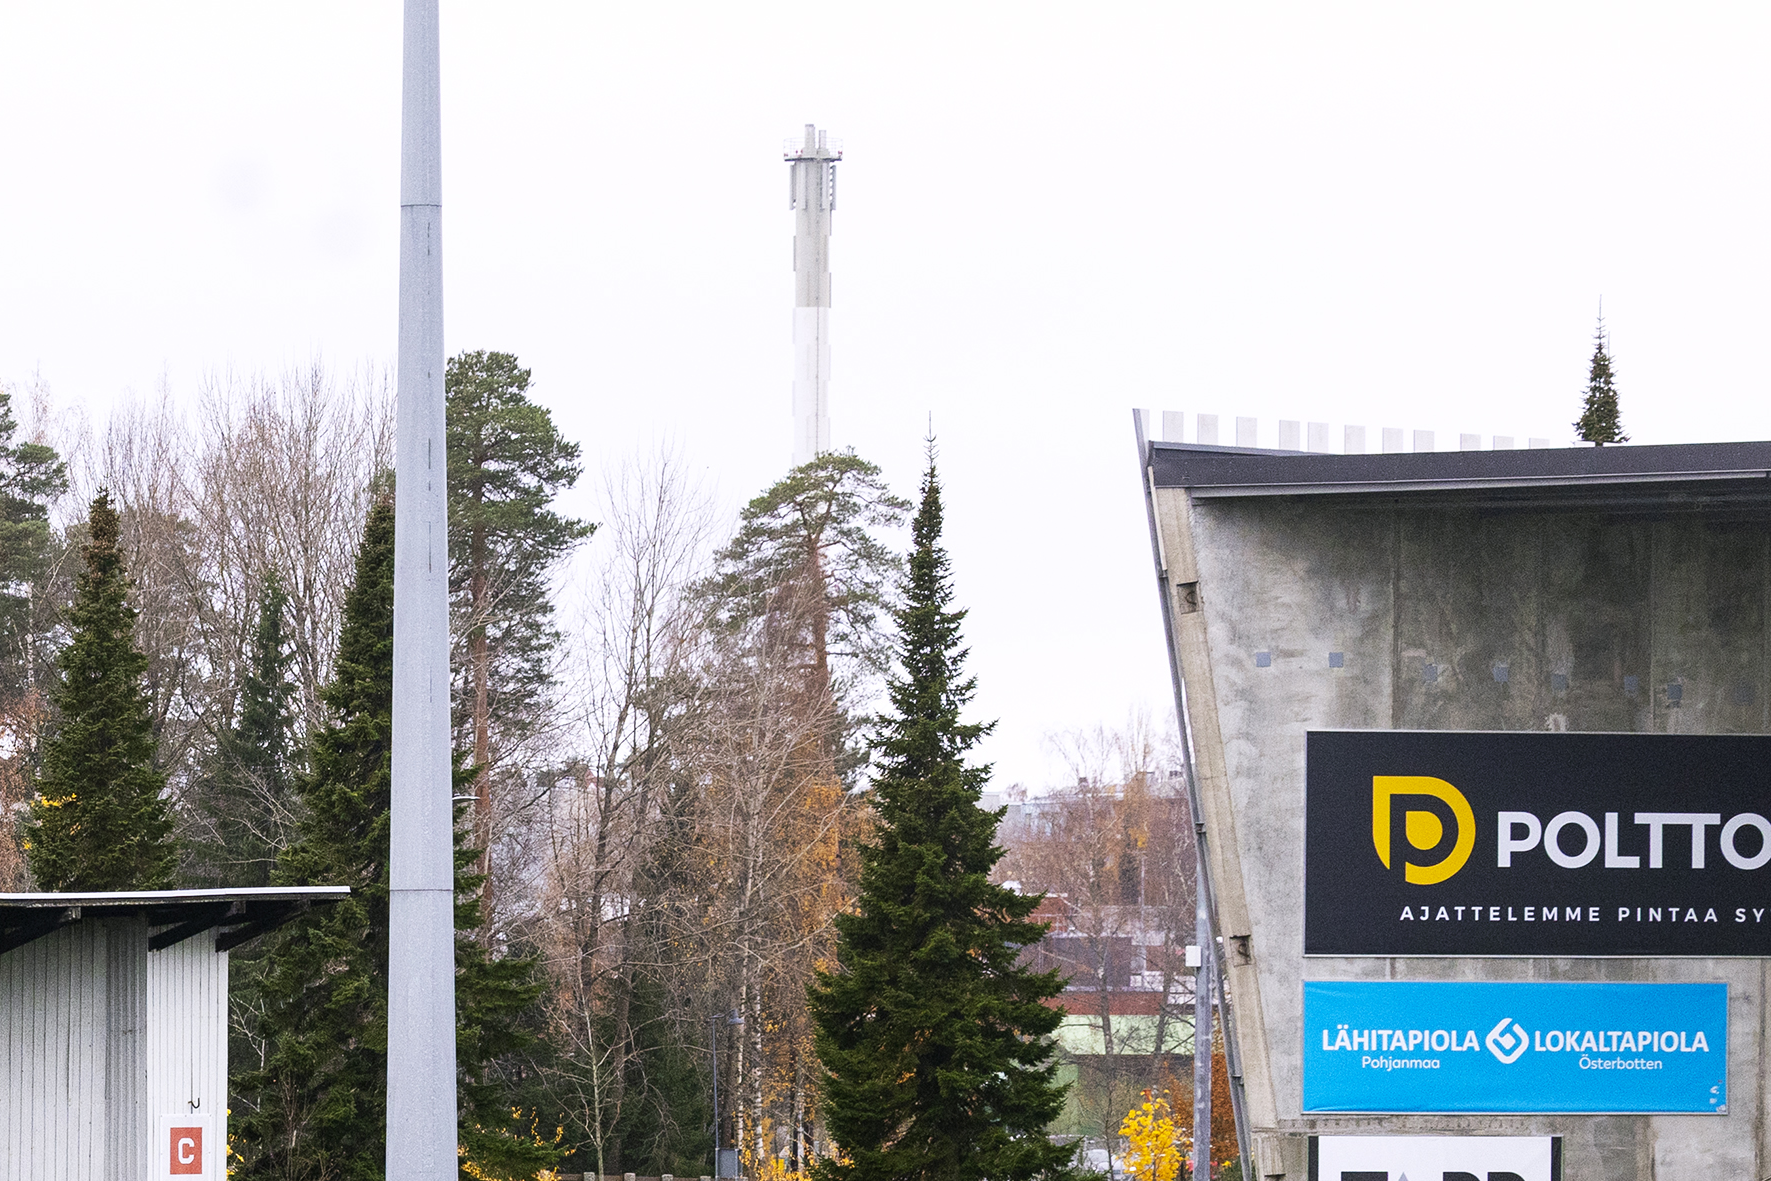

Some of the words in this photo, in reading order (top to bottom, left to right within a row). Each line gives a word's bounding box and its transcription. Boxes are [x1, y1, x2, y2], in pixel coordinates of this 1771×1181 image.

[1497, 810, 1771, 870] POLTTO
[1399, 906, 1601, 922] AJATTELEMME
[1618, 907, 1718, 922] PINTAA
[1322, 1024, 1480, 1052] LÄHITAPIOLA
[1535, 1030, 1709, 1053] LOKALTAPIOLA
[1362, 1056, 1440, 1072] Pohjanmaa
[1579, 1054, 1663, 1071] Österbotten
